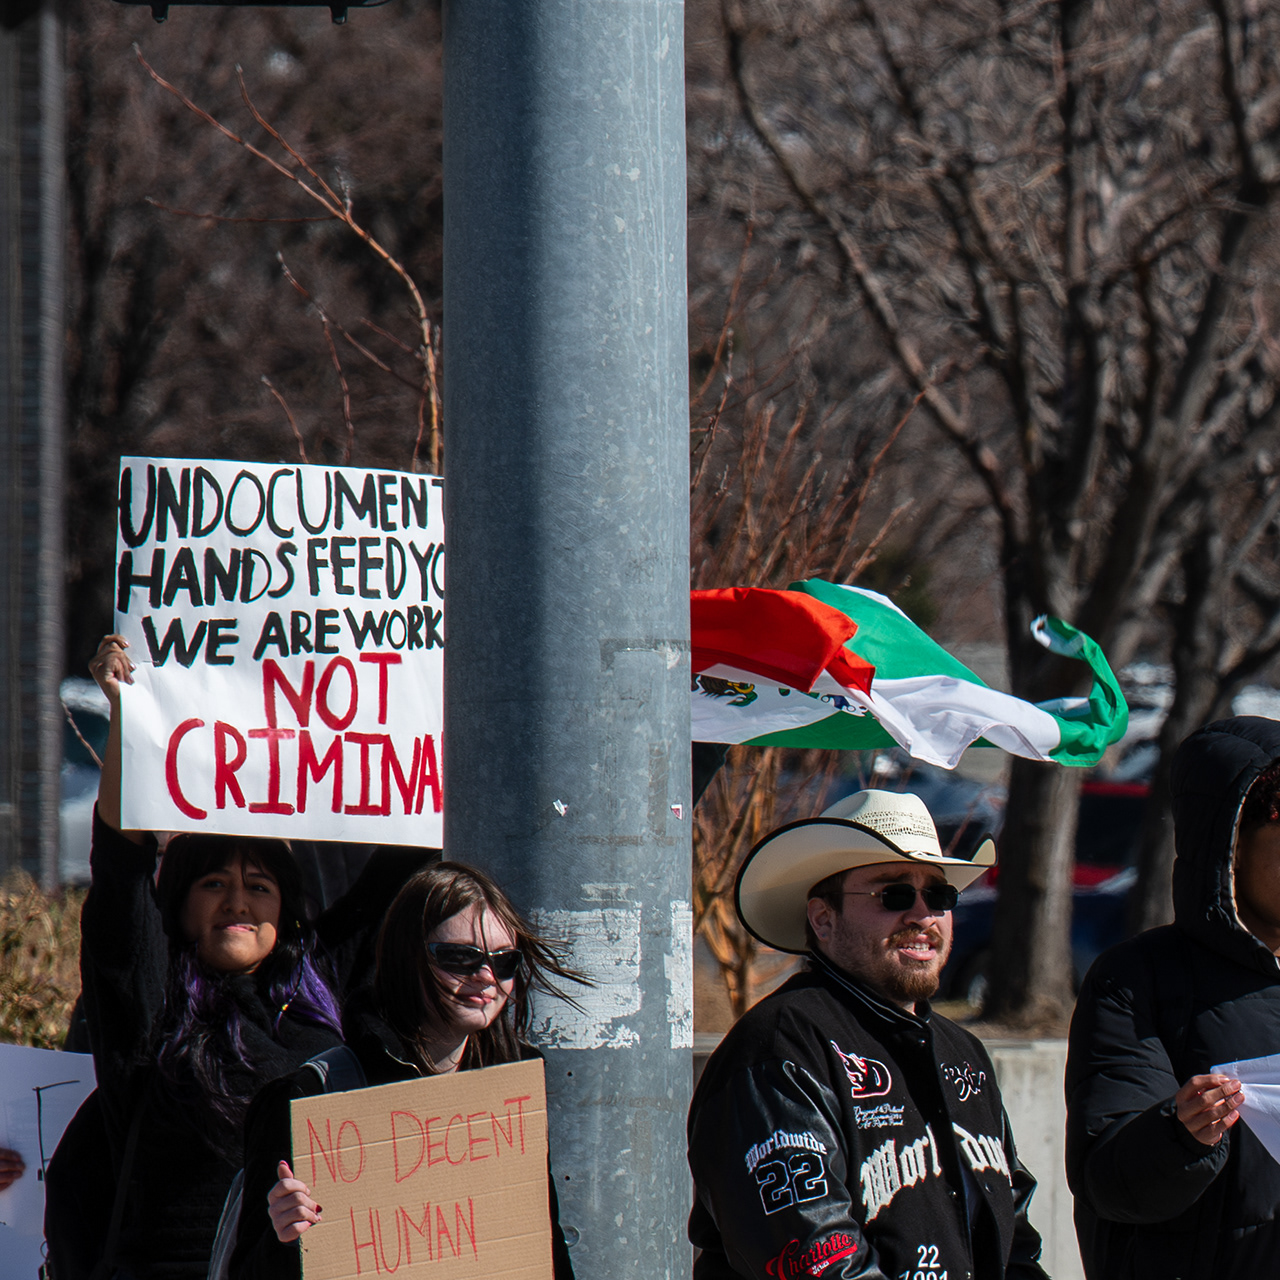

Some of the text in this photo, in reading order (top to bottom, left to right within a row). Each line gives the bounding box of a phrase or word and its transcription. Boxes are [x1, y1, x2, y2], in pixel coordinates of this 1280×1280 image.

[117, 541, 297, 613] HANDS
[308, 536, 407, 599] FEED
[142, 615, 240, 668] WE
[252, 608, 341, 660] ARE
[262, 651, 402, 731] NOT
[307, 1097, 531, 1187] NO DECENT
[745, 1129, 828, 1175] Worldwide
[754, 1152, 829, 1215] 22
[351, 1197, 478, 1275] HUMAN
[917, 1244, 941, 1268] 22
